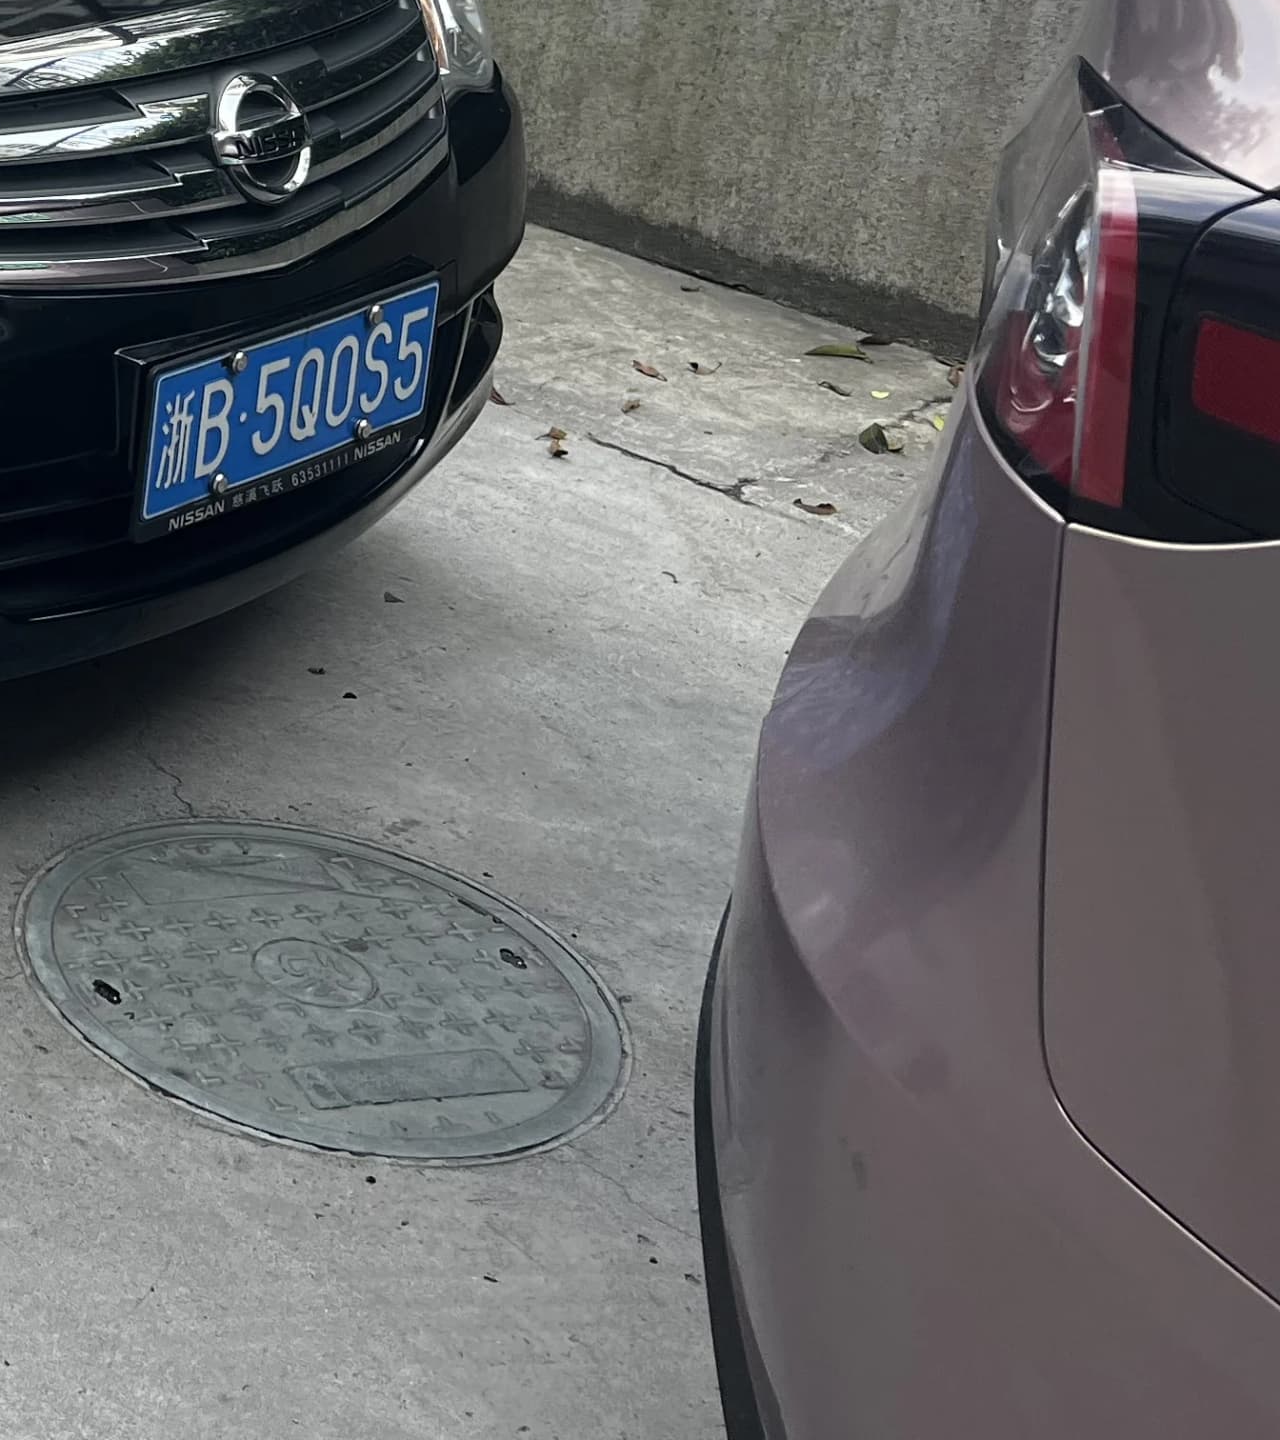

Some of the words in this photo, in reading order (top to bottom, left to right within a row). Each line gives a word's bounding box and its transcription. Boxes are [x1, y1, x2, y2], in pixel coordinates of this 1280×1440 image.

[168, 499, 225, 531] NISSAN
[291, 451, 349, 487] 63531111
[354, 430, 401, 461] NISSAN
